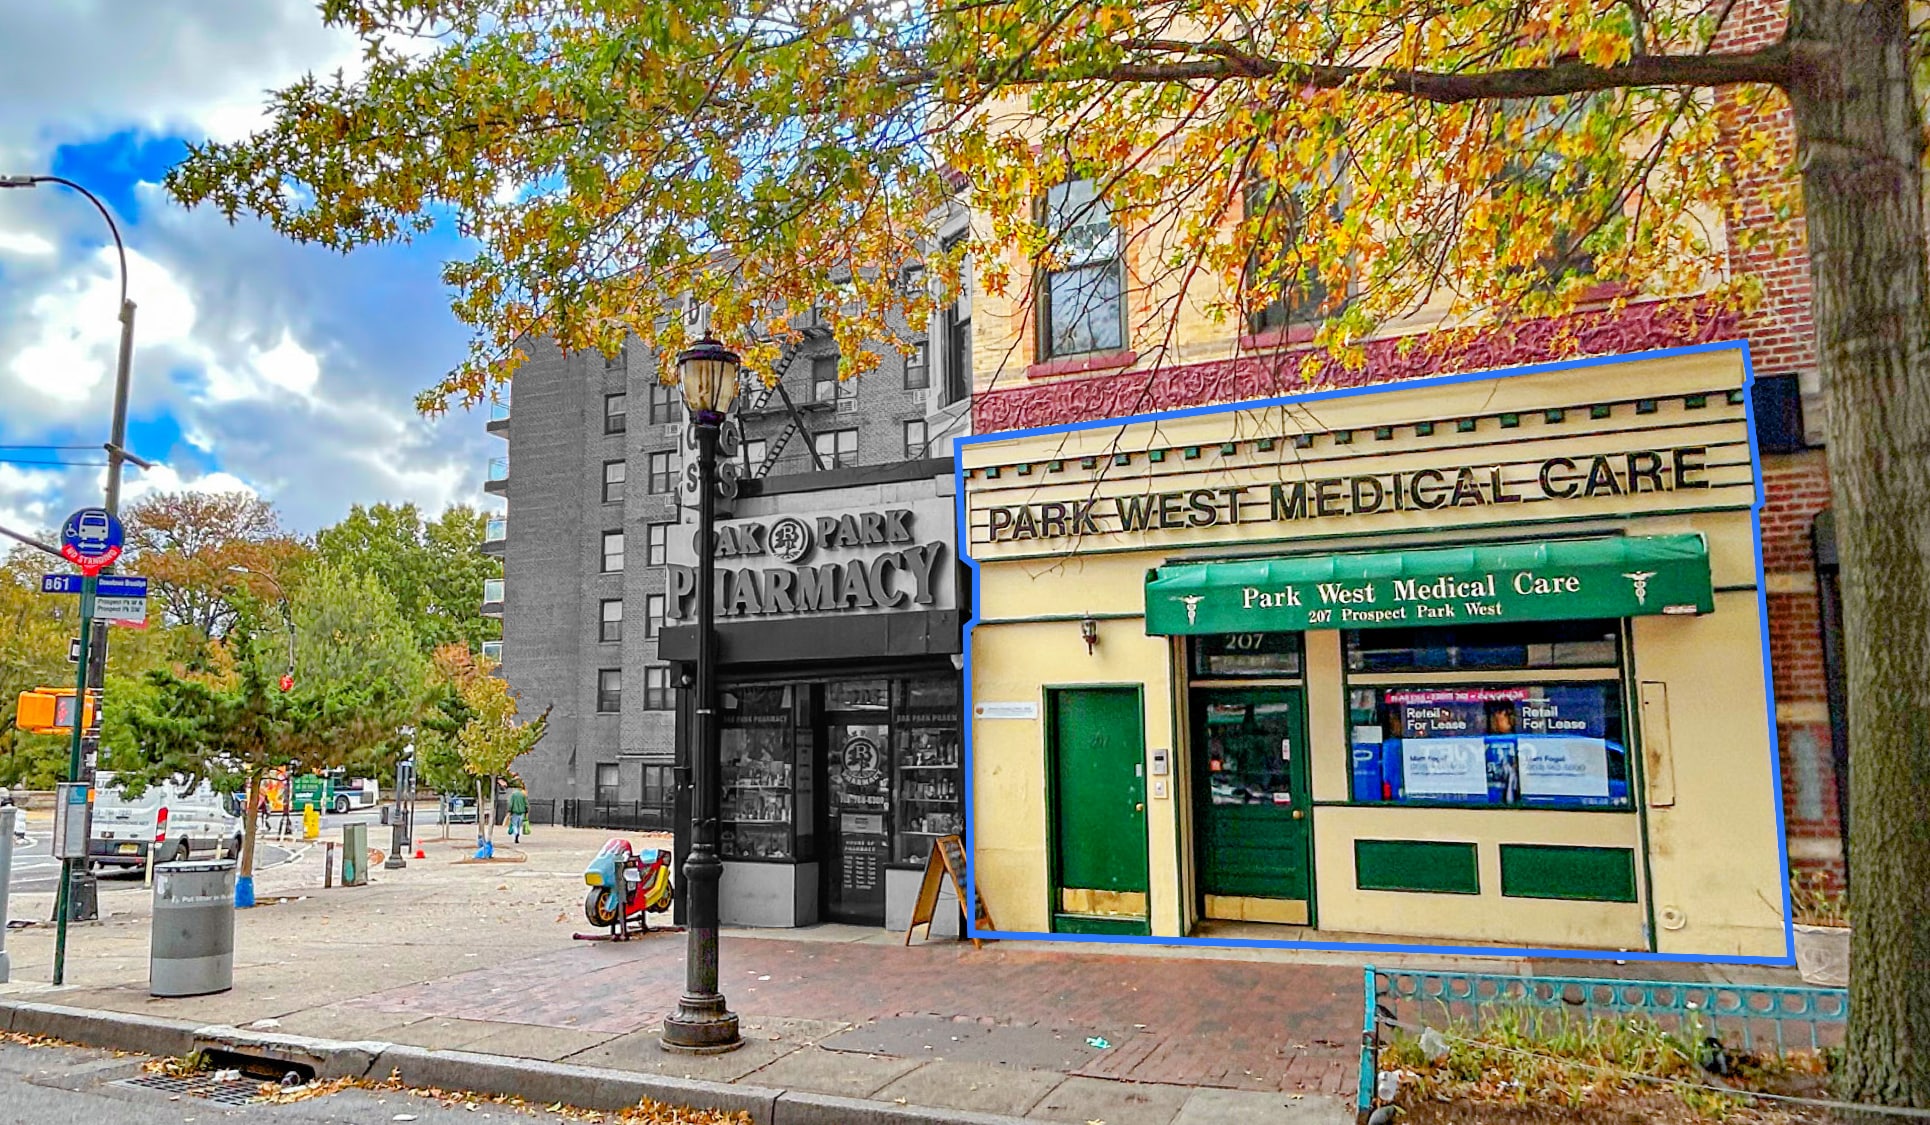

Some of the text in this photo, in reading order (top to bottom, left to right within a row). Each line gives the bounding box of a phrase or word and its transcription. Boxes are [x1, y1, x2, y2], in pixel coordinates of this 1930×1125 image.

[988, 446, 1710, 542] PARK WEST MEDICAL CARE
[816, 509, 913, 549] PARK
[66, 547, 118, 565] NO STANDING
[45, 577, 69, 590] B61
[1242, 571, 1580, 609] Park West Medical Care
[1308, 602, 1503, 623] 207 Prospect Park West
[1225, 634, 1263, 649] 207
[1406, 707, 1440, 719] Retail
[1522, 706, 1558, 718] Retail
[1407, 720, 1466, 730] For Lease
[1523, 719, 1587, 729] For Lease
